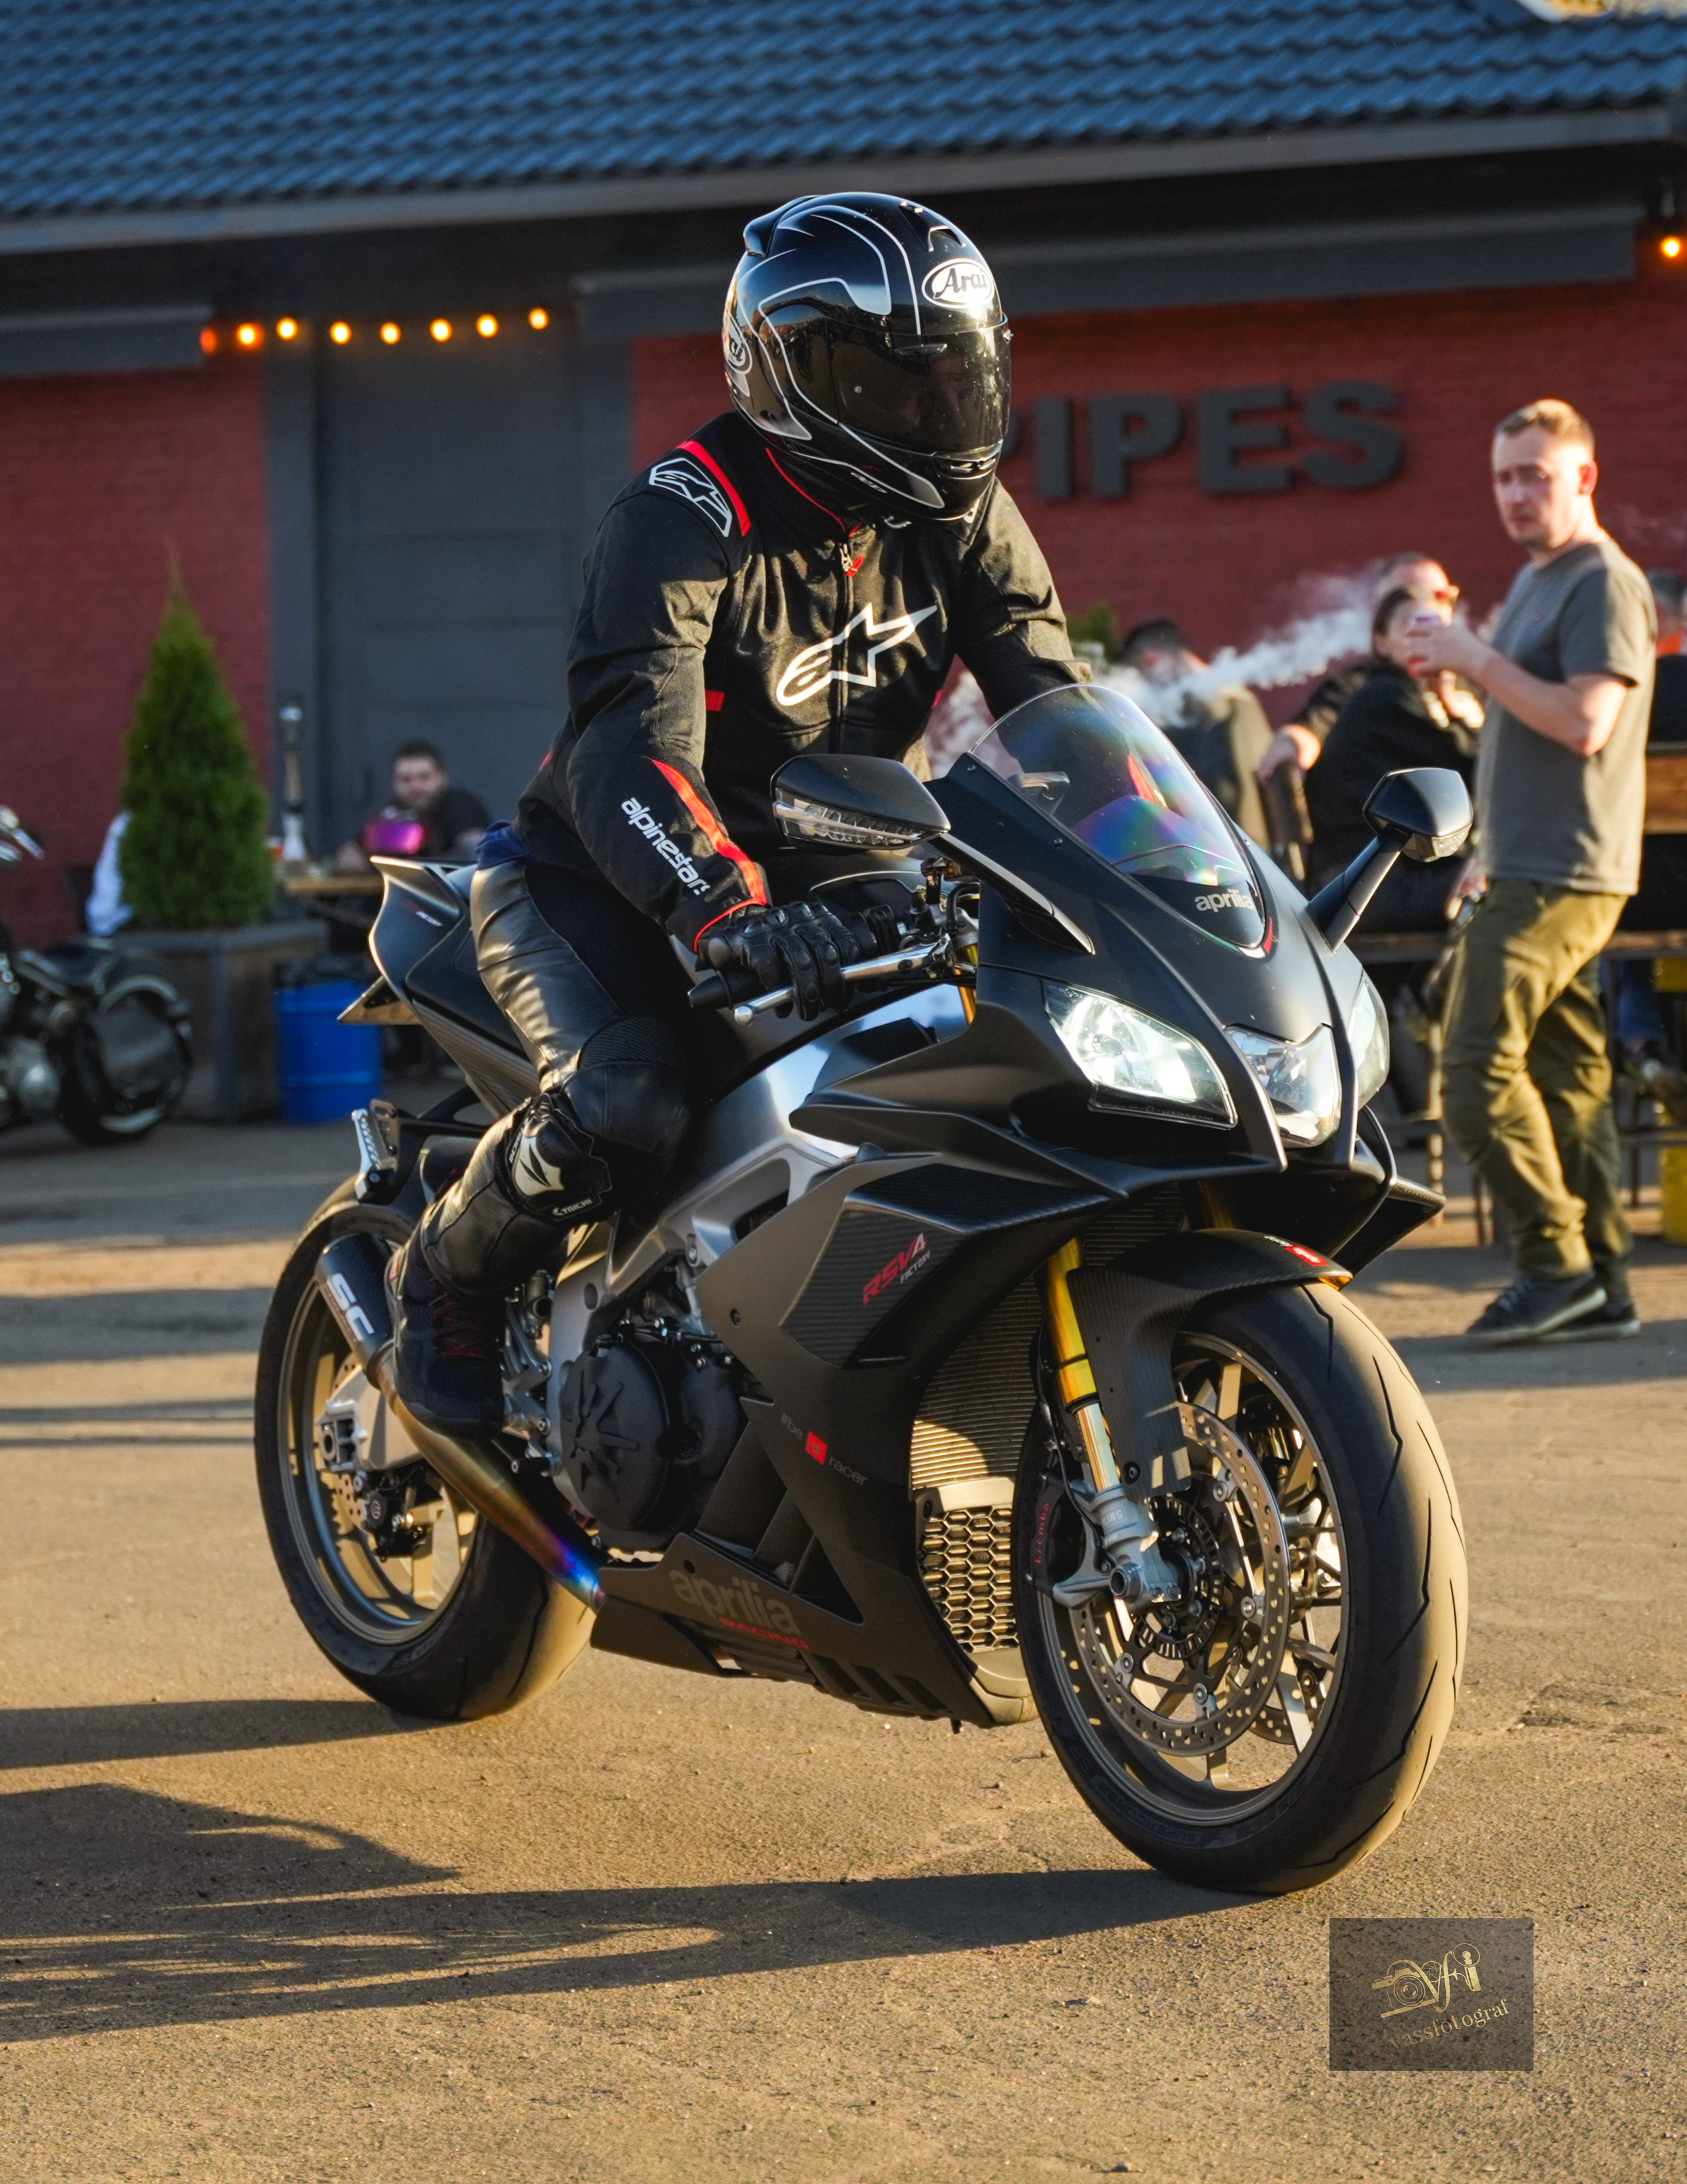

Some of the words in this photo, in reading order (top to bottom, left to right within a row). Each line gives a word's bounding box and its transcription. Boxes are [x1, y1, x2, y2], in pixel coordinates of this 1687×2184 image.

[933, 267, 988, 299] Arai
[1000, 380, 1405, 499] IPES
[1194, 889, 1257, 912] aprilia
[863, 1232, 928, 1306] RSV4
[900, 1250, 930, 1283] FACTORY
[326, 1272, 374, 1341] SC
[828, 1455, 869, 1485] racer
[1033, 1501, 1050, 1565] brembo
[668, 1569, 803, 1637] aprilia
